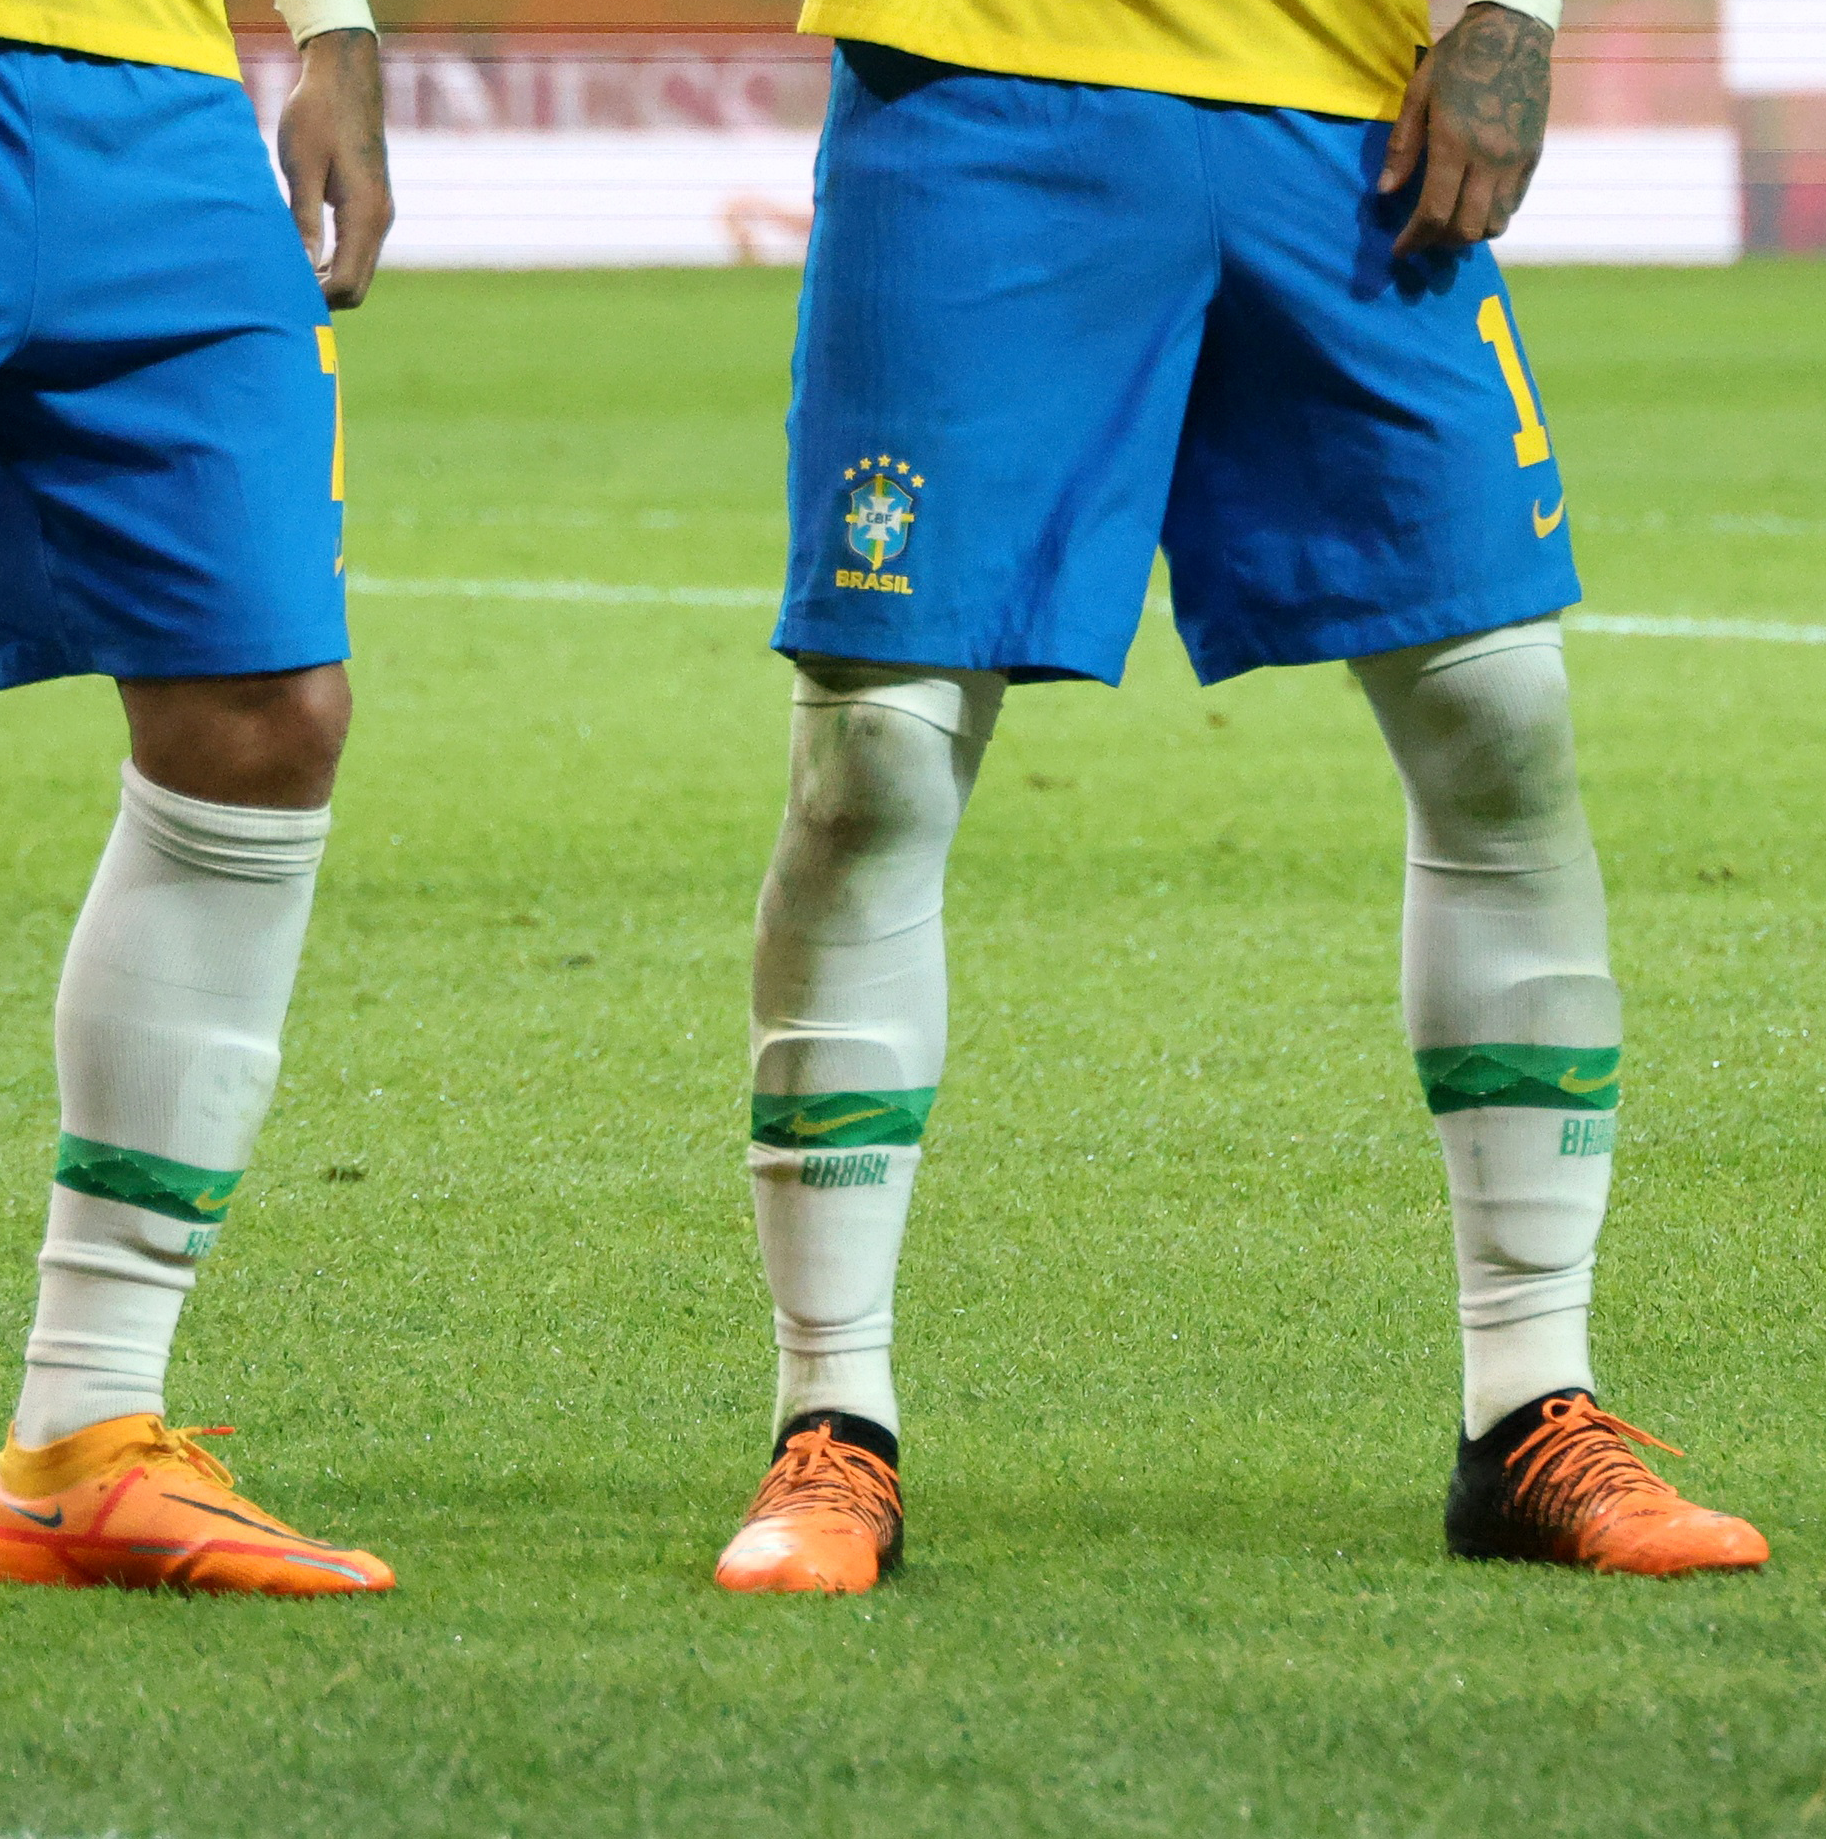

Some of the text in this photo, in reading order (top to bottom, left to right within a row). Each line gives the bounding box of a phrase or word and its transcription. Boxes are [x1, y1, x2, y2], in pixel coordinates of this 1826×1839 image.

[1476, 295, 1550, 468] 1
[866, 512, 892, 524] CBF
[836, 570, 913, 594] BRASIL
